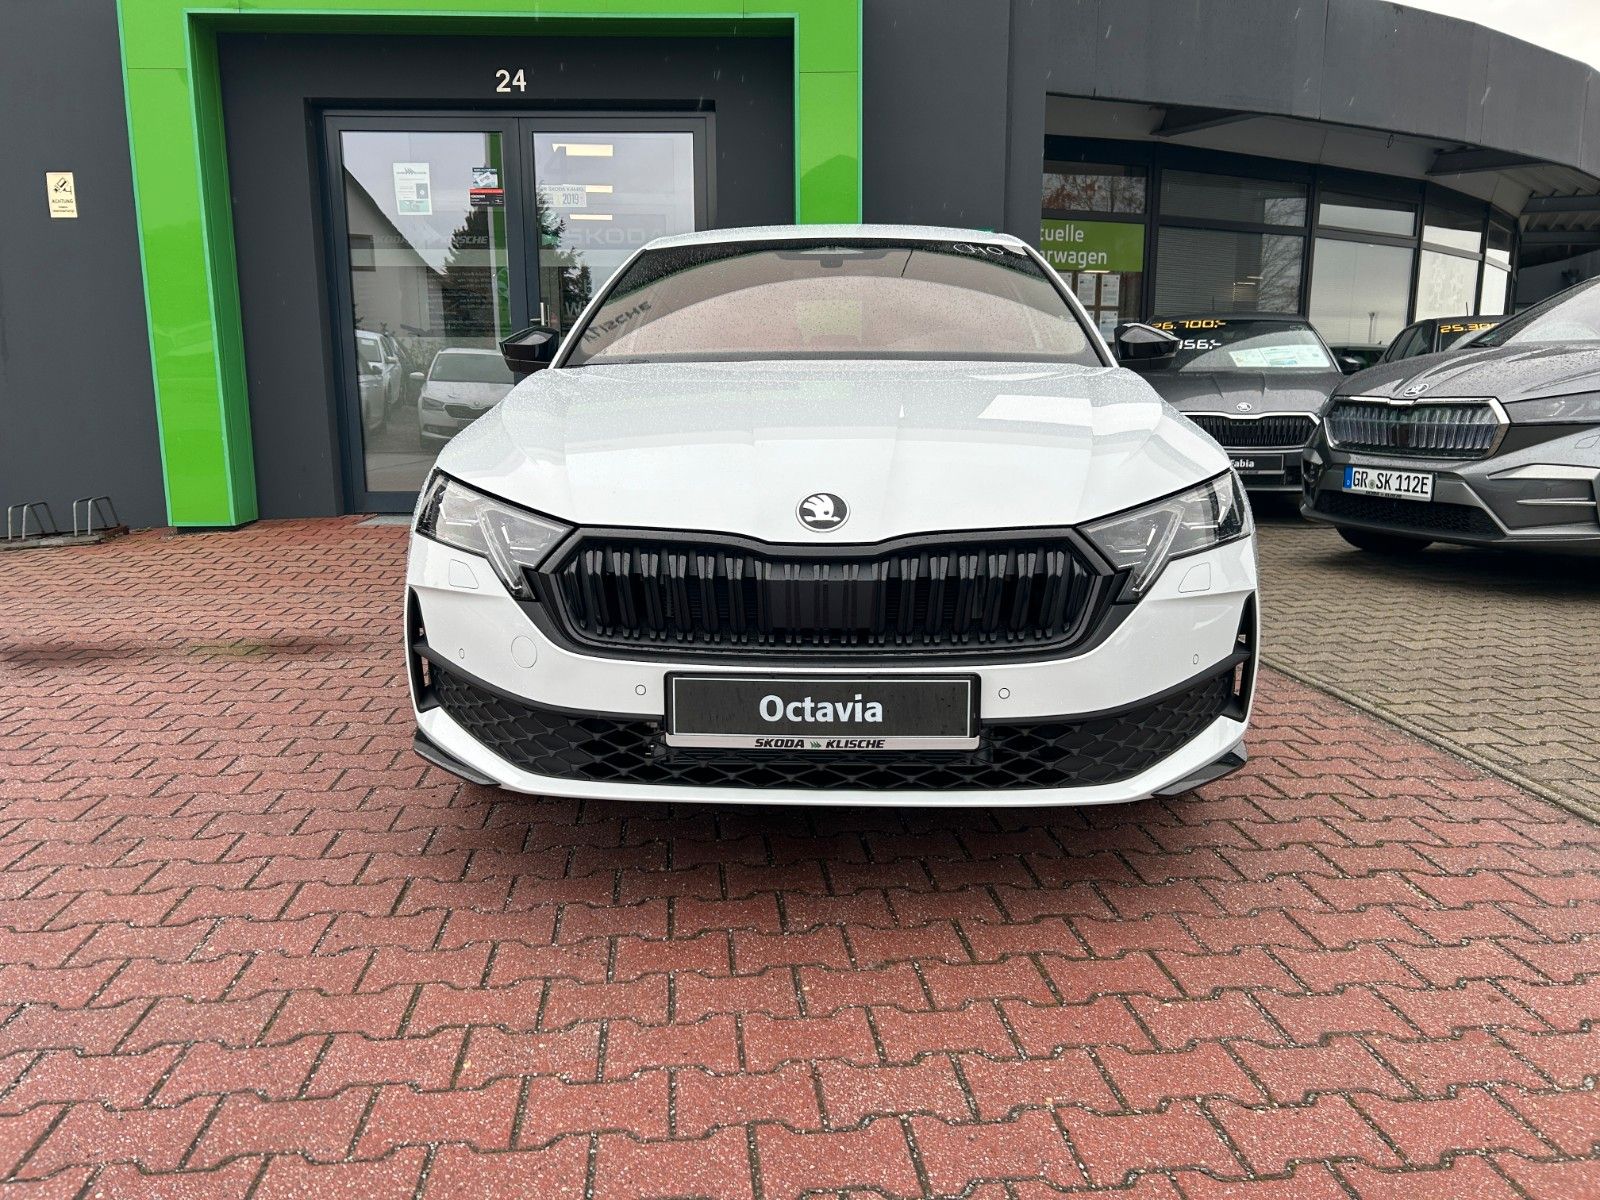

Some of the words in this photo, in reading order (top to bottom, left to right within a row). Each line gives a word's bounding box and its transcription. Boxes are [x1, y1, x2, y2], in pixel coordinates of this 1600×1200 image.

[495, 69, 527, 92] 24
[1352, 471, 1368, 488] GR
[1376, 473, 1393, 490] SK
[1395, 474, 1430, 494] 112E
[759, 693, 883, 724] Octavia
[825, 739, 886, 748] KLISCHE
